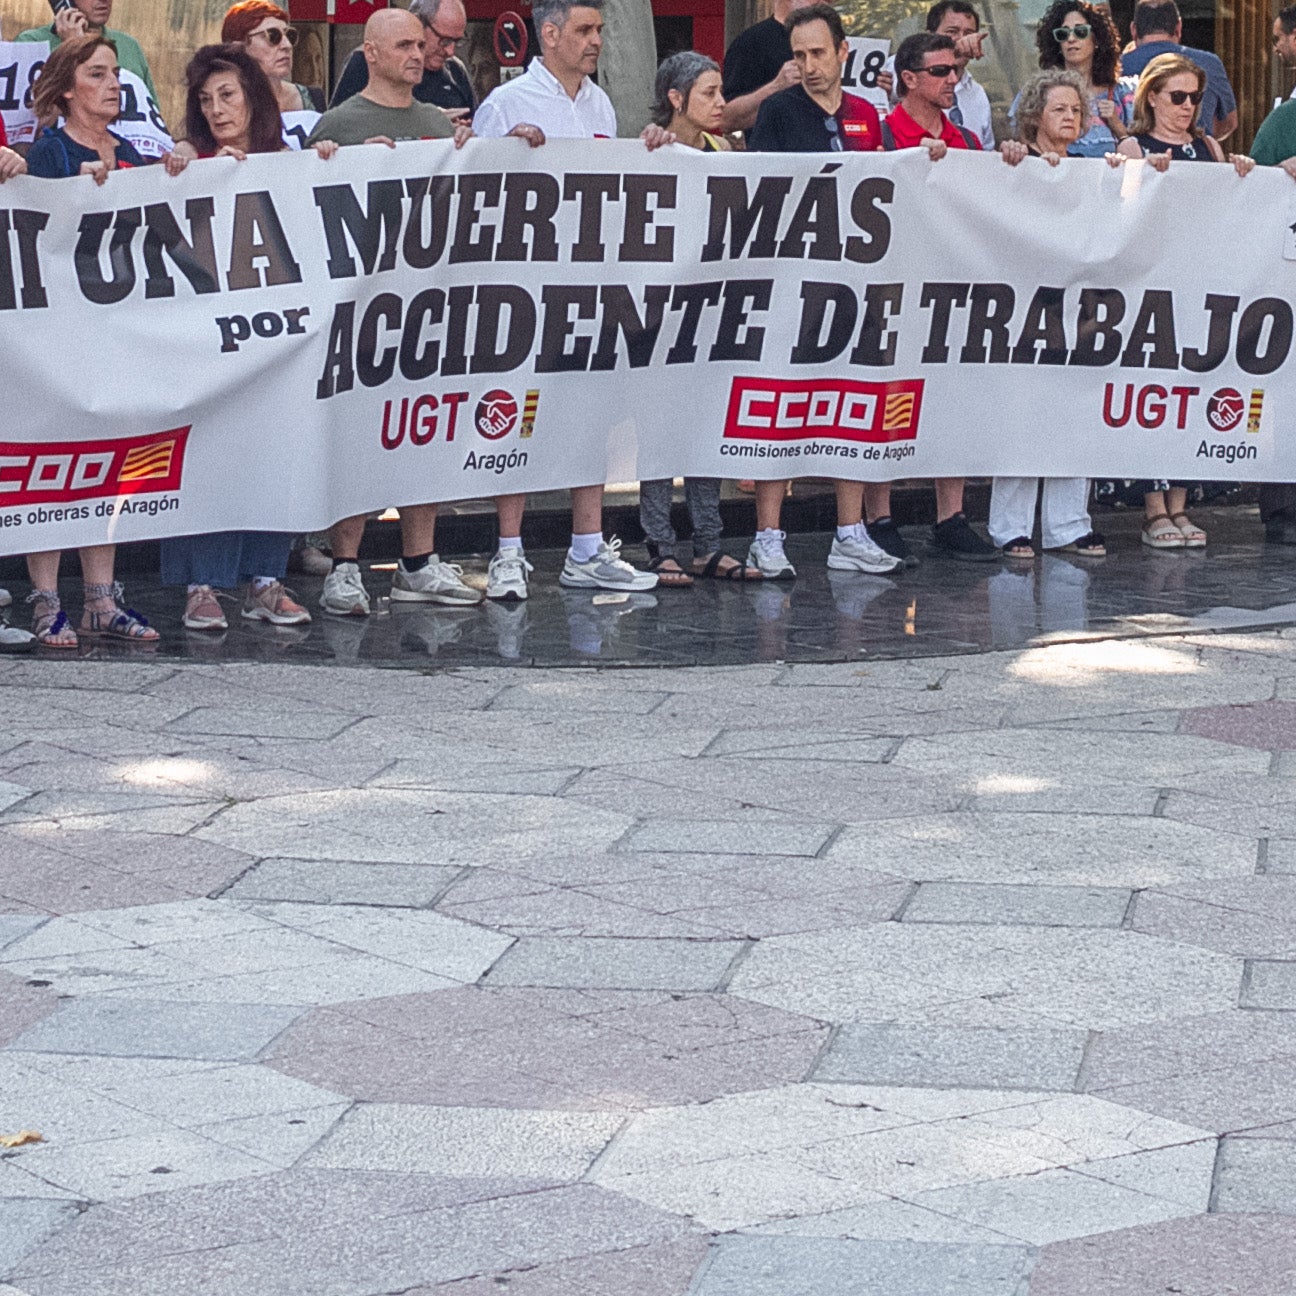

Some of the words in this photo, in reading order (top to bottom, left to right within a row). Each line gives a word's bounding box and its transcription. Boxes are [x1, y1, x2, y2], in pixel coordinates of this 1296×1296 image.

[842, 50, 886, 88] 18
[74, 190, 303, 305] UNA
[312, 171, 678, 280] MUERTE
[700, 162, 895, 265] MÁS
[215, 306, 310, 353] por
[316, 279, 774, 400] ACCIDENTE
[790, 280, 904, 366] DE
[919, 281, 1294, 375] TRABAJO
[380, 391, 470, 451] UGT
[736, 389, 878, 431] CCOO
[1102, 382, 1200, 429] UGT
[463, 448, 528, 475] Aragón
[719, 442, 801, 459] comisiones
[803, 441, 858, 459] obreras
[862, 445, 881, 460] de
[882, 442, 916, 461] Aragón
[1196, 440, 1258, 464] Aragón
[27, 504, 90, 525] obreras
[94, 500, 115, 518] de
[119, 495, 180, 517] Aragón
